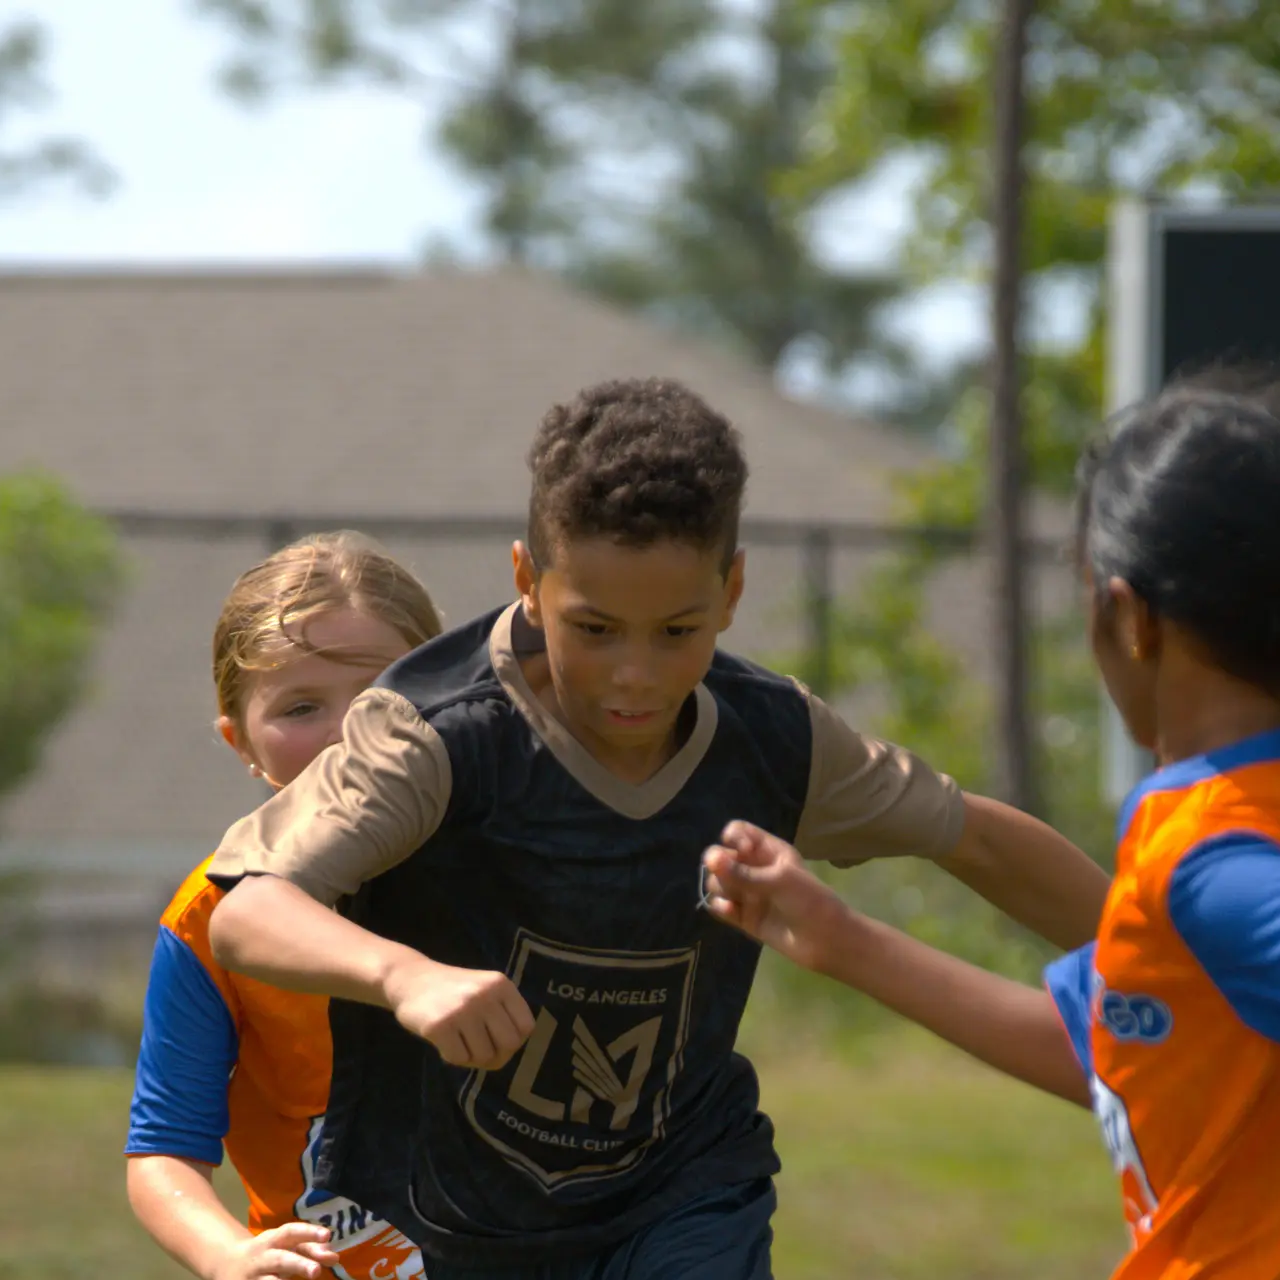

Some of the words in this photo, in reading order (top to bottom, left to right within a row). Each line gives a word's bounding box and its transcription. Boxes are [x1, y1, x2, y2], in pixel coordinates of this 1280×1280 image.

[547, 979, 586, 1001] LOS
[586, 988, 668, 1005] ANGELES
[496, 1109, 579, 1149] FOOTBALL
